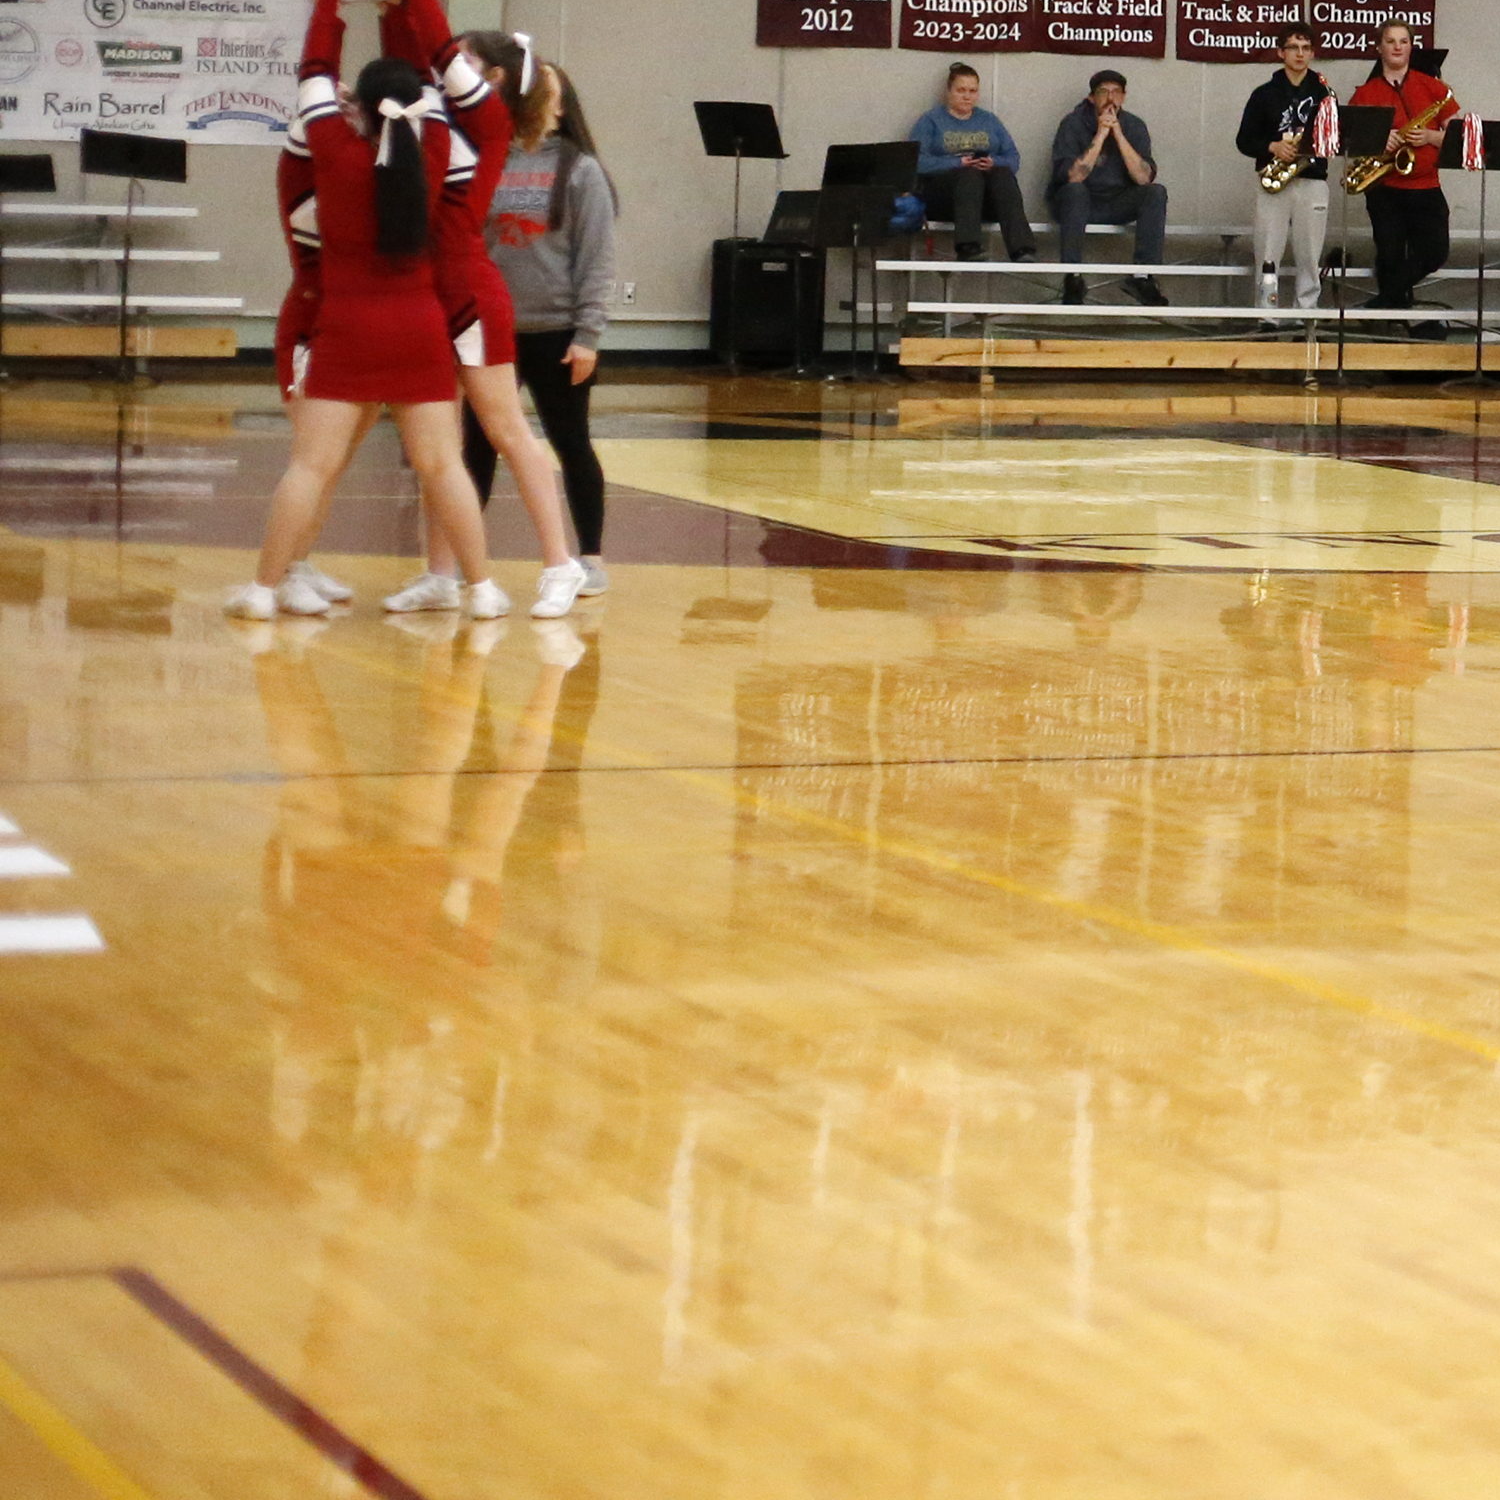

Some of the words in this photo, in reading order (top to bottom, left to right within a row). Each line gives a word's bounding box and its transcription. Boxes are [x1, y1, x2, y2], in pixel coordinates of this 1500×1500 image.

[133, 0, 185, 10] Channel
[243, 3, 266, 13] Inc.
[1117, 0, 1162, 16] Field
[801, 9, 853, 30] 2012
[914, 20, 1021, 41] 2023-2024
[104, 50, 172, 60] MADISON
[220, 39, 265, 58] Interiors
[197, 60, 259, 74] ISLAND
[43, 93, 92, 117] Rain
[101, 93, 166, 117] Barrel
